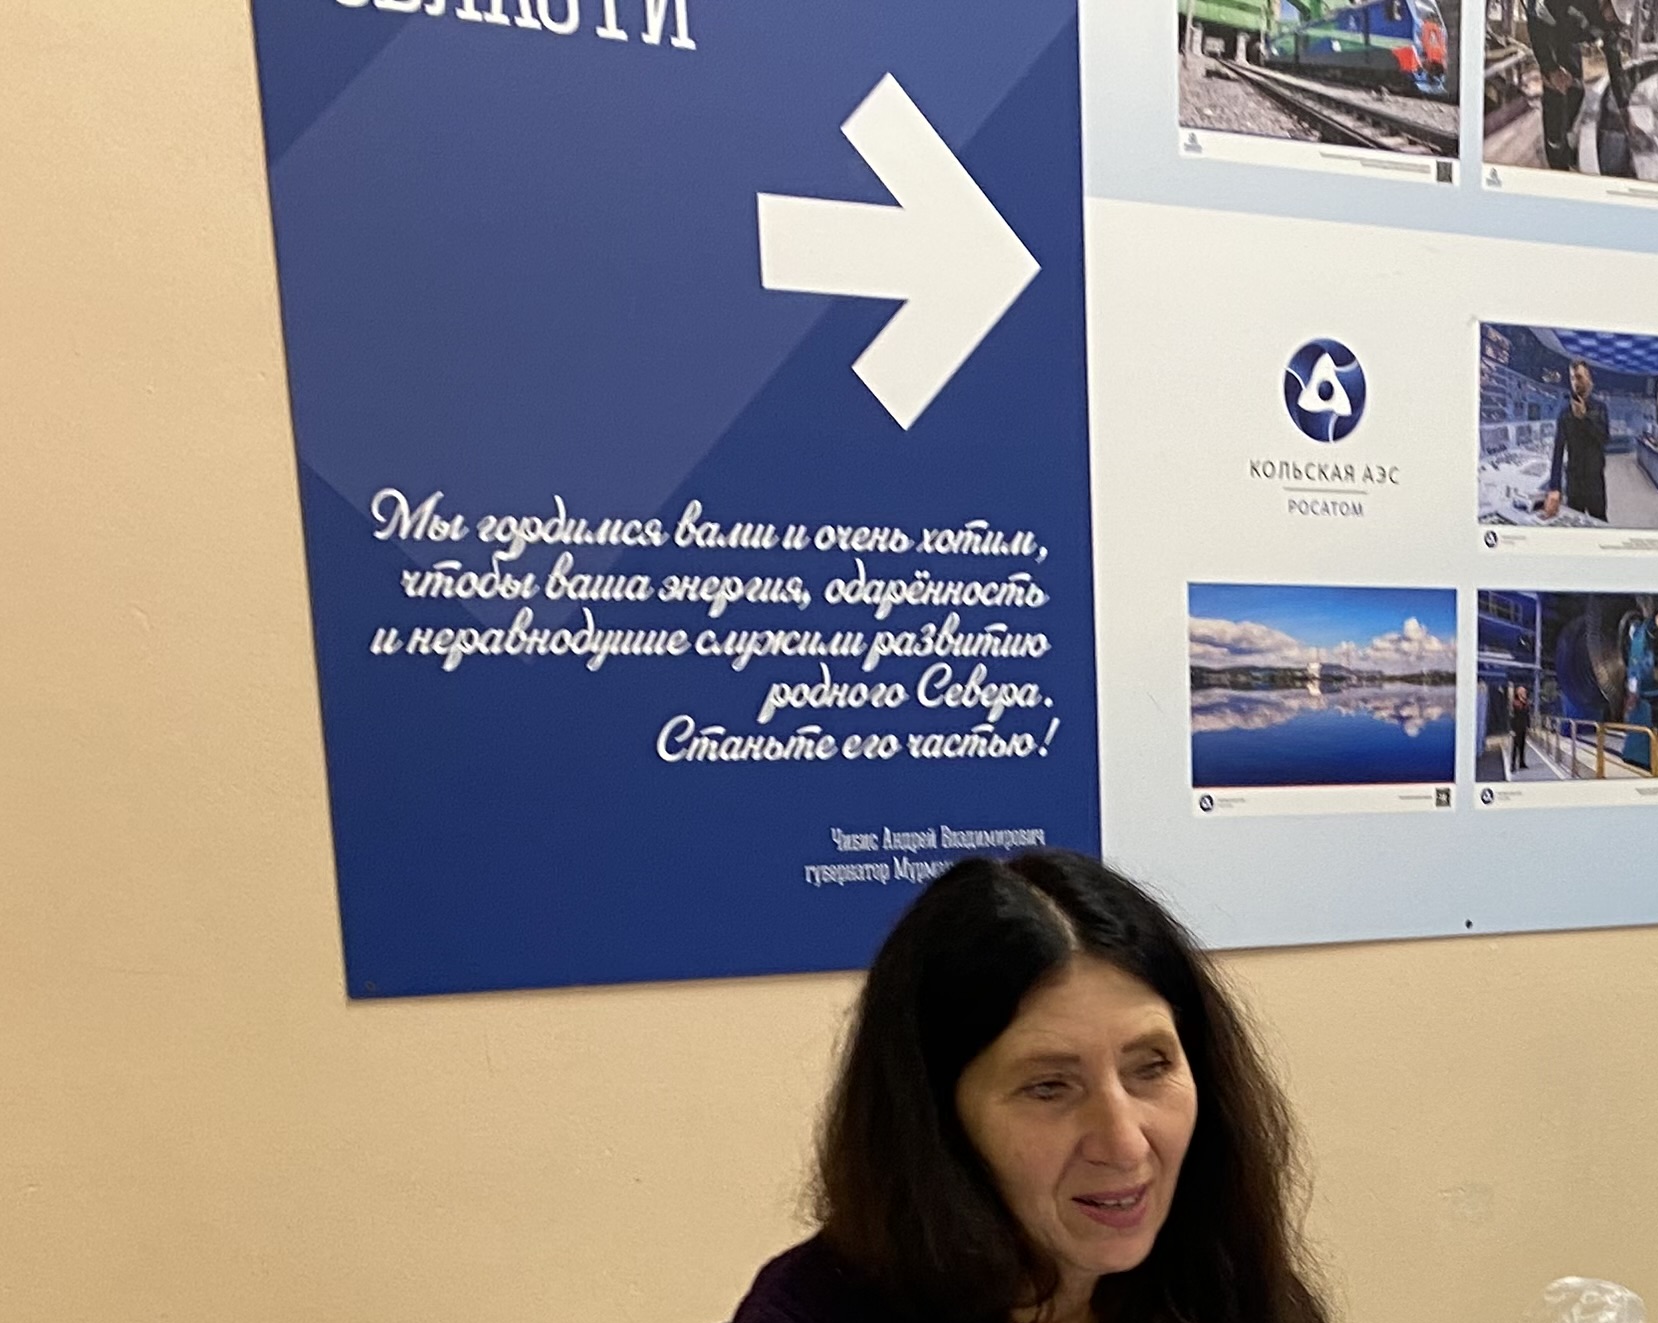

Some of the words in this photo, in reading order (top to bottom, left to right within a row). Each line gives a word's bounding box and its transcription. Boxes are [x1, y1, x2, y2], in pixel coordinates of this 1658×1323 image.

[1249, 459, 1355, 483] КОЛЬСКАЯ
[1361, 464, 1400, 485] АЭС
[371, 488, 468, 541] Мы
[477, 494, 669, 561] гордимся
[674, 499, 779, 549] вами
[781, 524, 811, 549] и
[814, 525, 915, 552] очень
[916, 519, 1048, 564] хотим,
[1287, 499, 1364, 518] РОСАТОМ
[401, 556, 540, 600] чтобы
[545, 551, 656, 601] ваша
[658, 576, 811, 618] энергия,
[824, 558, 1051, 620] одарённость
[370, 628, 403, 655] и
[406, 606, 691, 671] неравнодушие
[695, 630, 867, 672] служили
[862, 611, 1051, 672] развитию
[757, 662, 909, 724] родного
[917, 662, 1054, 723] Севера.
[656, 714, 839, 762] Станьте
[841, 733, 900, 760] его
[907, 717, 1060, 759] частью!
[830, 827, 878, 852] Чибис
[882, 826, 938, 854] Андрей
[940, 825, 1047, 851] Владимирович
[804, 863, 890, 887] губернатор
